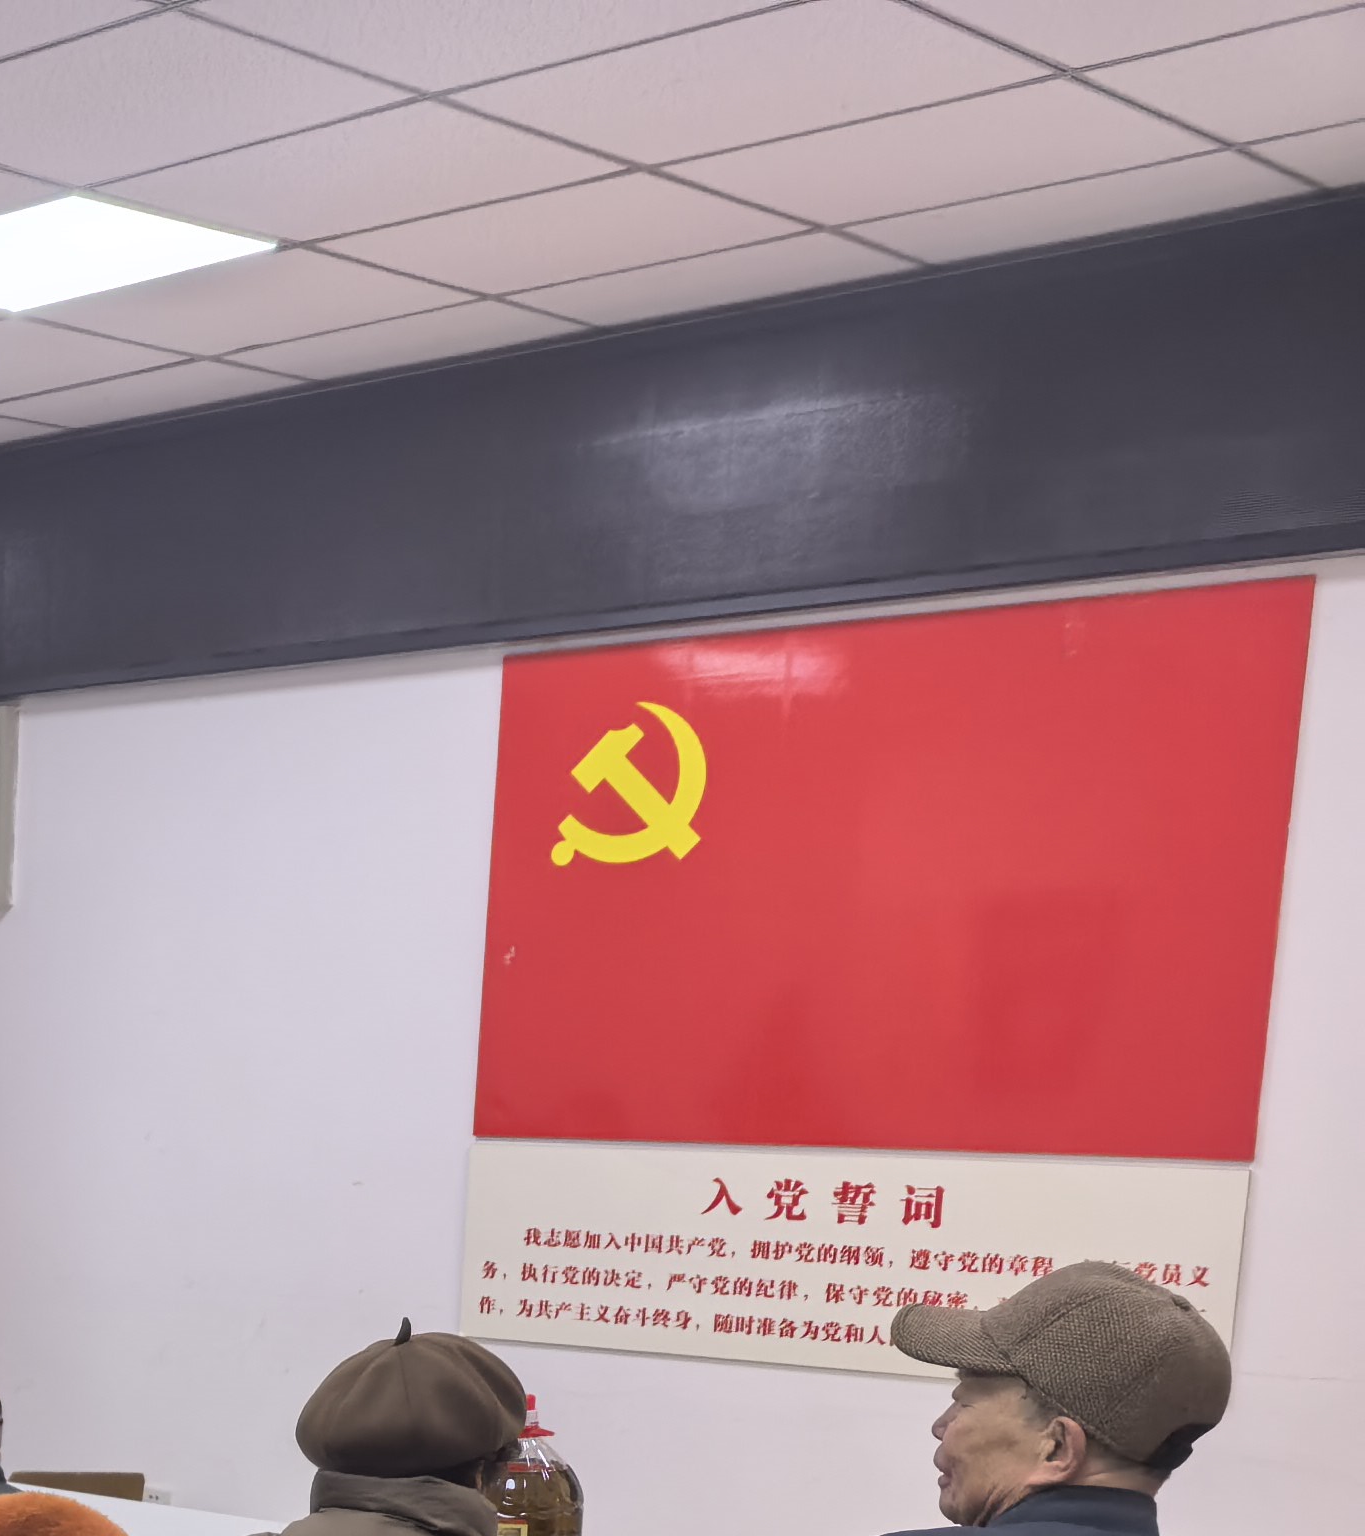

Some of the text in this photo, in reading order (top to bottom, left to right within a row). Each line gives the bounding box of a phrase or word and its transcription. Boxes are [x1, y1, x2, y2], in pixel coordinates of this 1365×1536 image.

[701, 1177, 944, 1228] 入党誓词
[479, 1296, 895, 1347] 作，为共产主义奋斗终身，随时准备为党和人
